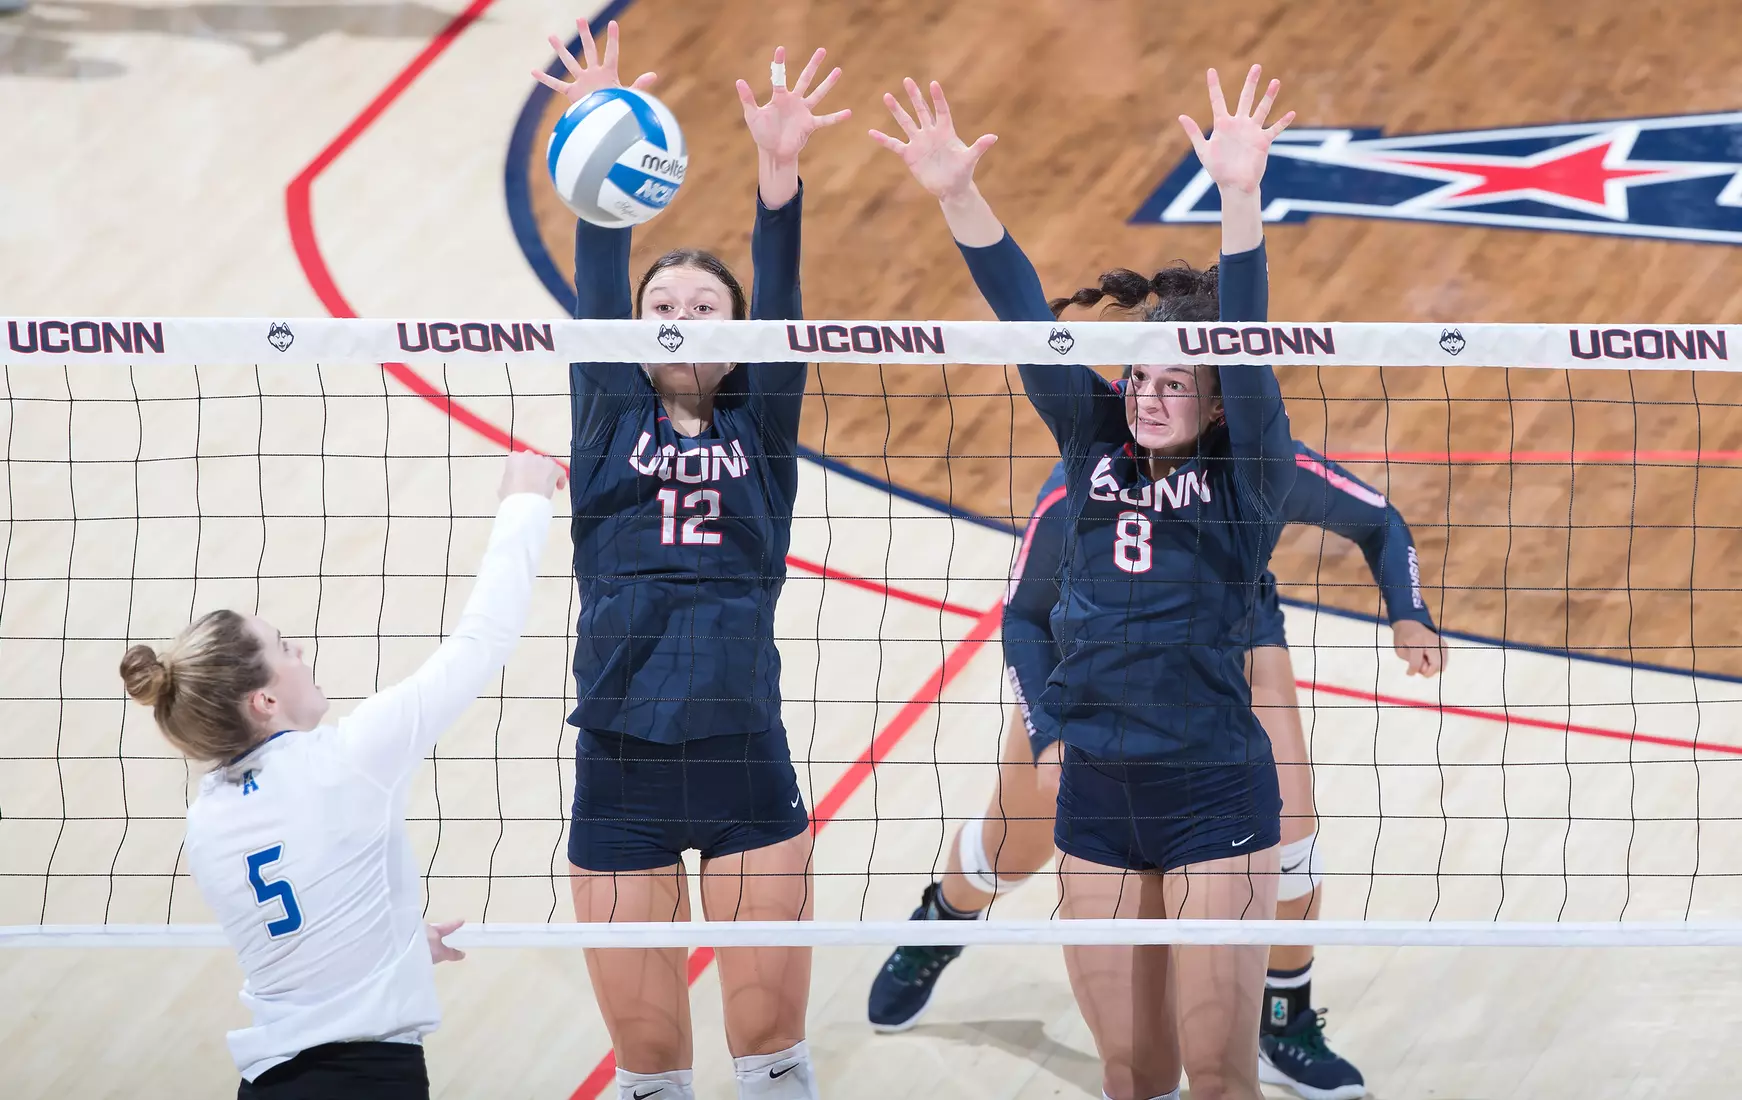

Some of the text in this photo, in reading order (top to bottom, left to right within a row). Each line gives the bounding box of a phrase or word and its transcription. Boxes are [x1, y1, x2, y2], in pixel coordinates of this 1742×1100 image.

[641, 153, 684, 180] molte
[7, 320, 165, 353] UCONN
[397, 322, 556, 353] UCONN
[786, 324, 945, 354] UCONN
[1177, 327, 1335, 356] UCONN
[1569, 329, 1728, 360] UCONN
[656, 487, 723, 546] 12
[1113, 509, 1153, 575] 8
[245, 842, 304, 939] 5
